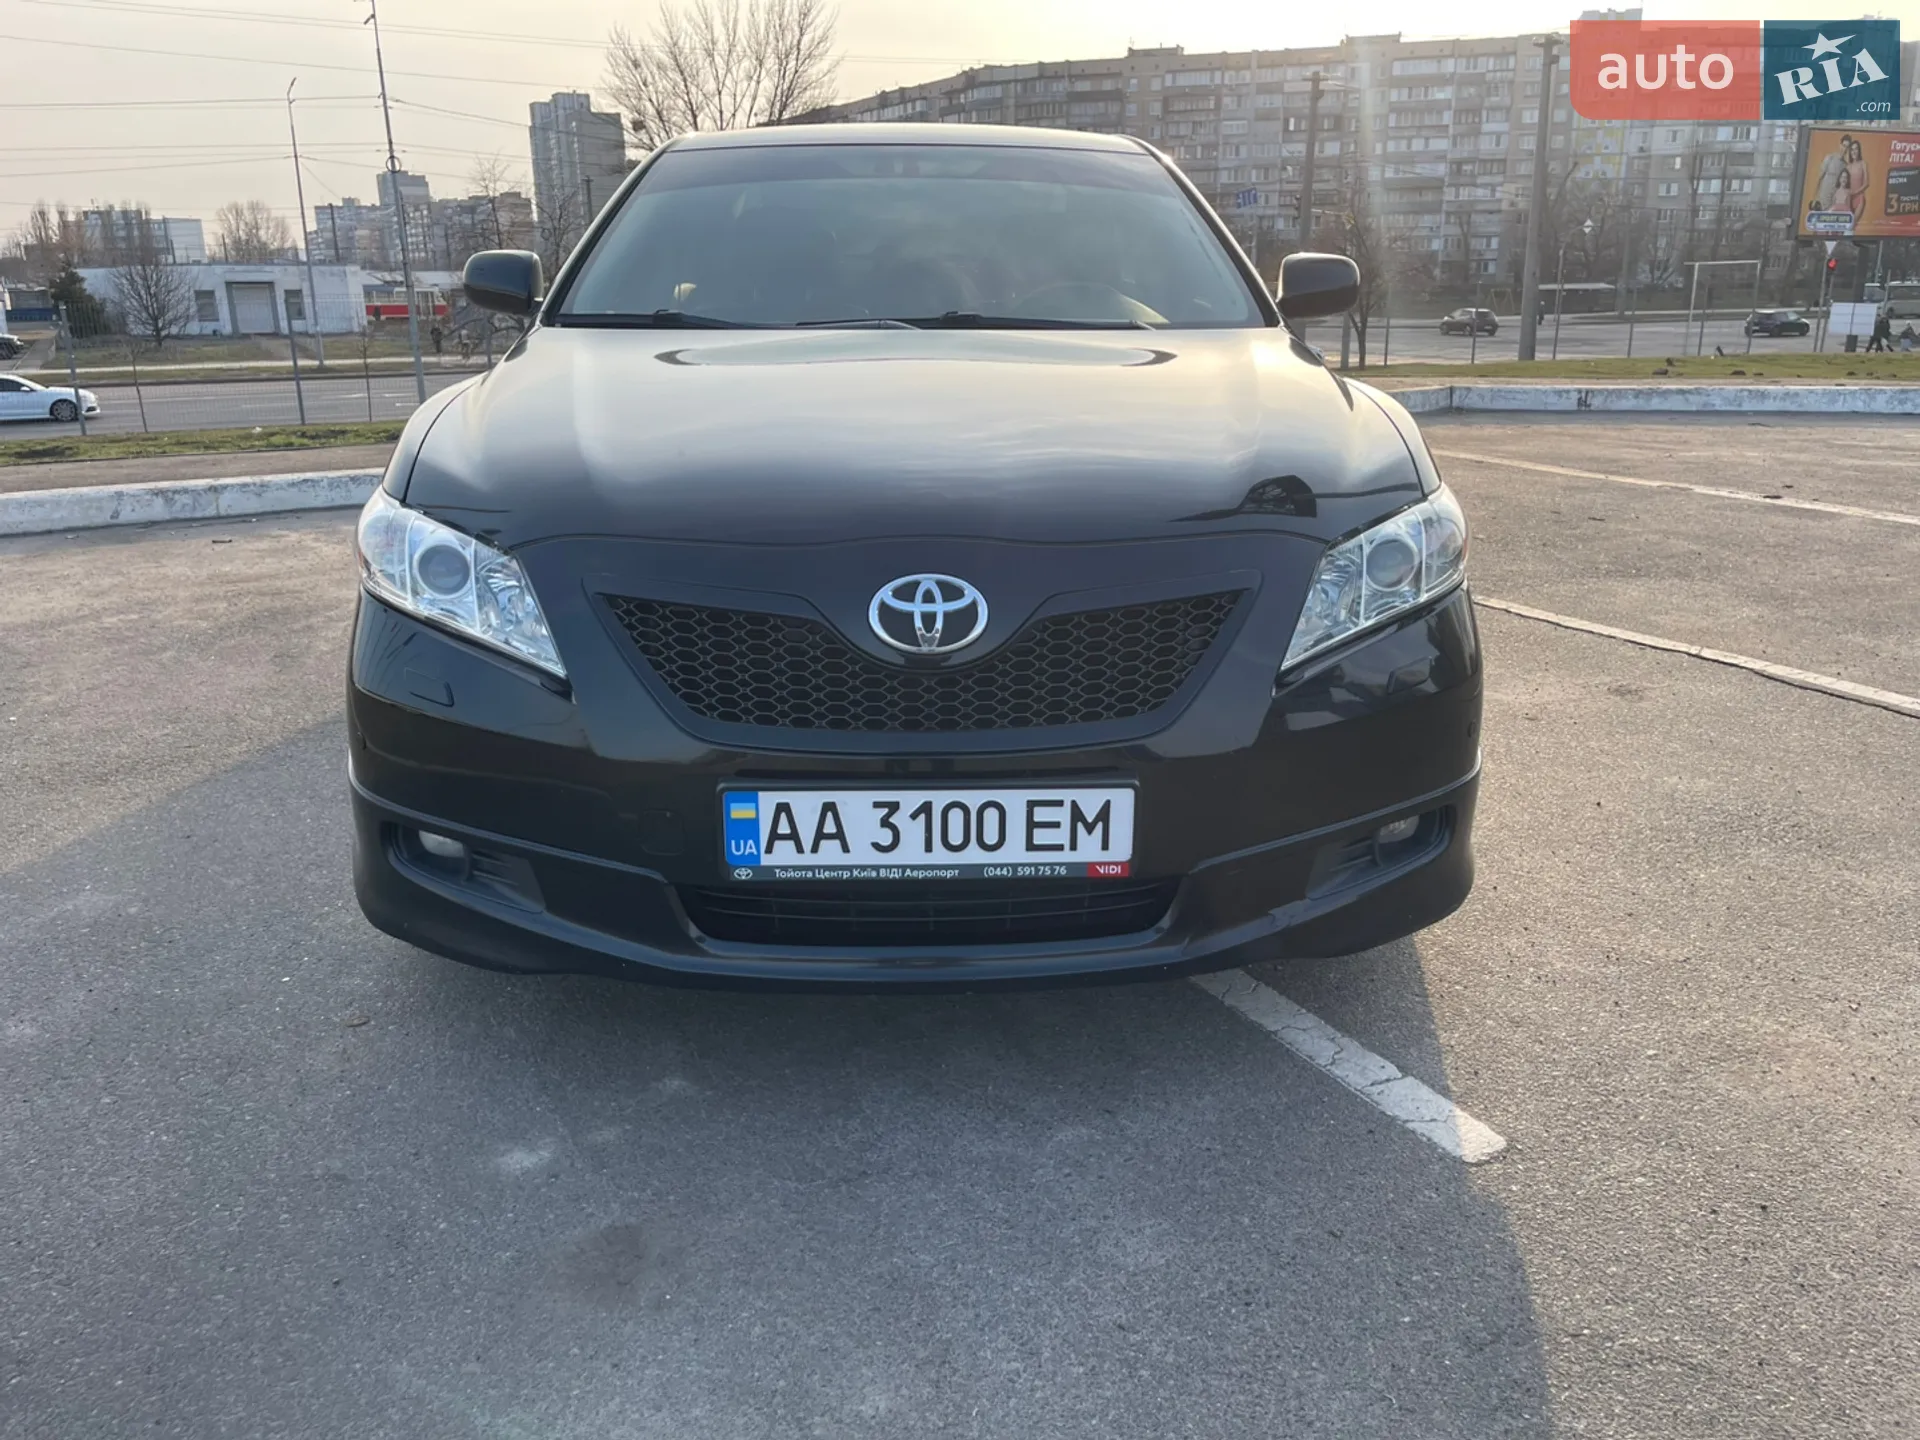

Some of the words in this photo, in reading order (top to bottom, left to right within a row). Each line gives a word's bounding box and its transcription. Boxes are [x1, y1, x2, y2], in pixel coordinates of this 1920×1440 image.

[1887, 193, 1899, 213] 3
[764, 801, 850, 855] AA
[870, 800, 1007, 854] 3100
[1025, 799, 1112, 852] EM
[731, 839, 758, 856] UA
[774, 868, 812, 878] Тойота
[815, 868, 850, 880] Центр
[852, 867, 877, 878] Київ
[879, 868, 901, 879] ВІДІ
[904, 867, 959, 879] Аеропорт
[984, 865, 1013, 877] (044)
[1017, 865, 1035, 876] 591
[1038, 865, 1051, 876] 75
[1053, 865, 1067, 875] 76
[1095, 864, 1121, 874] VIDI
